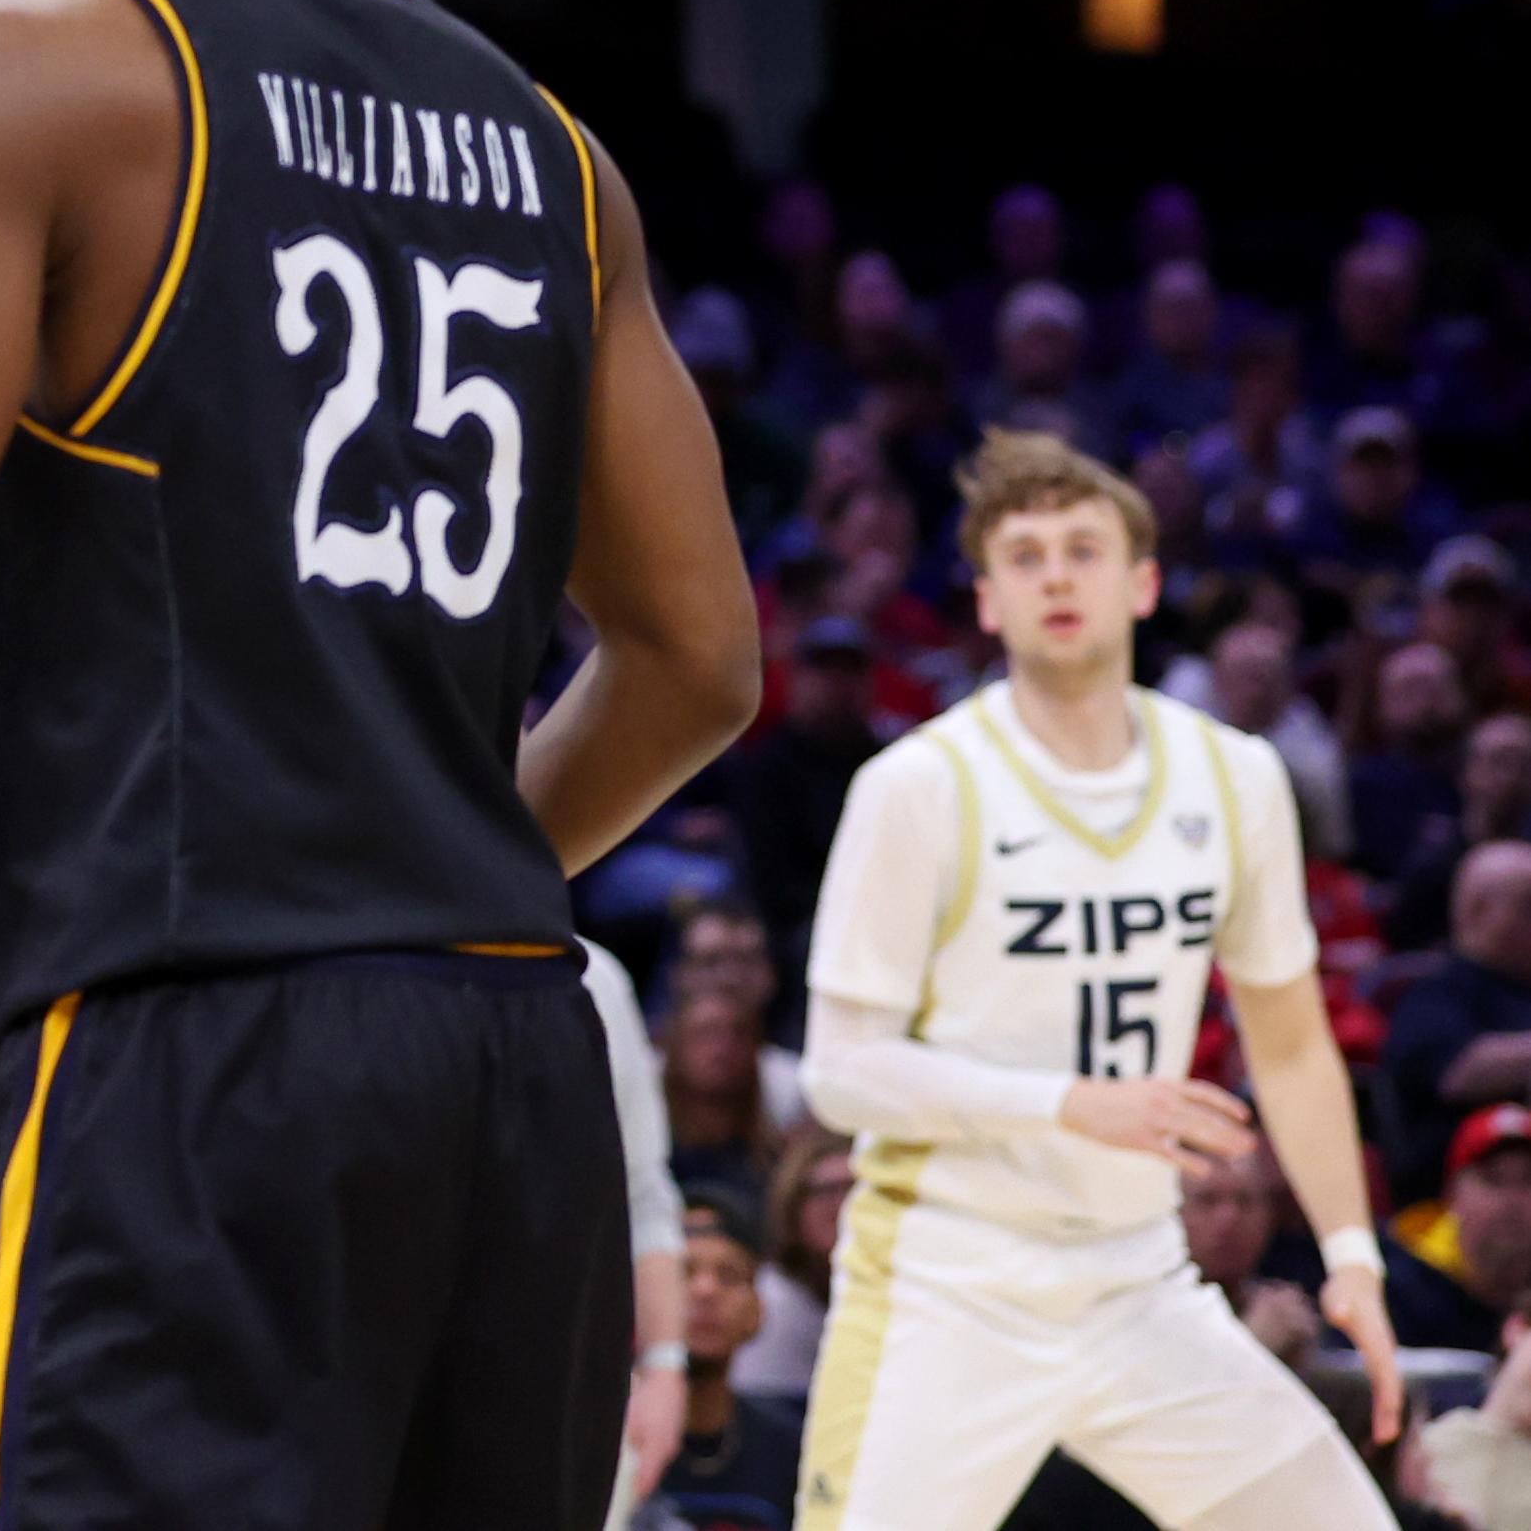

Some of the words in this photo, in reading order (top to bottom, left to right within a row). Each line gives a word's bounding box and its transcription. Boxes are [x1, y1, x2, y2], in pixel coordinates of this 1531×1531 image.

[257, 72, 543, 217] WILLIAMSON
[272, 234, 544, 619] 25
[1005, 888, 1216, 955] ZIPS
[1078, 978, 1159, 1080] 15
